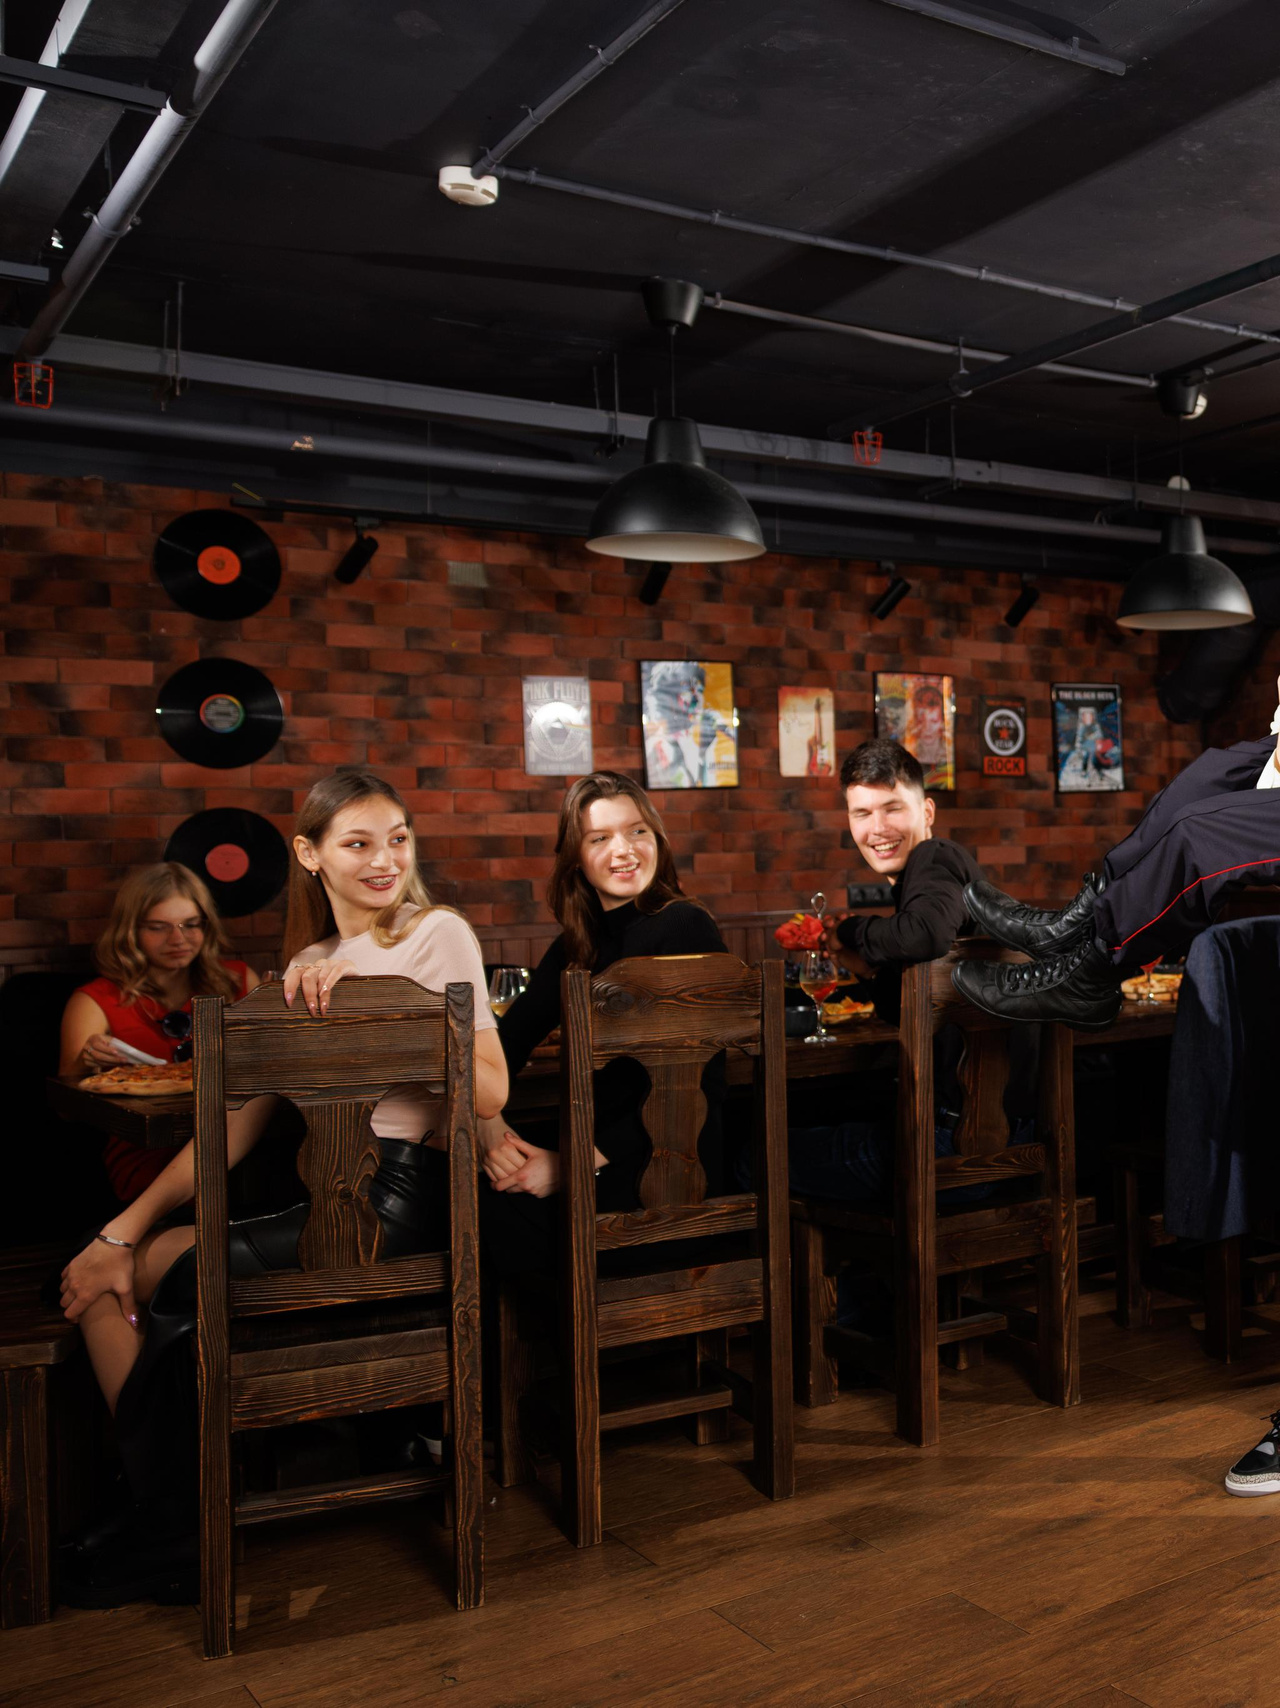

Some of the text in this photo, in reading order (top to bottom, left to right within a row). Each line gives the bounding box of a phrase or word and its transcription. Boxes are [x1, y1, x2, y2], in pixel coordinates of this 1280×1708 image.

[523, 681, 589, 701] PINK FLOYD
[987, 759, 1022, 772] ROCK
